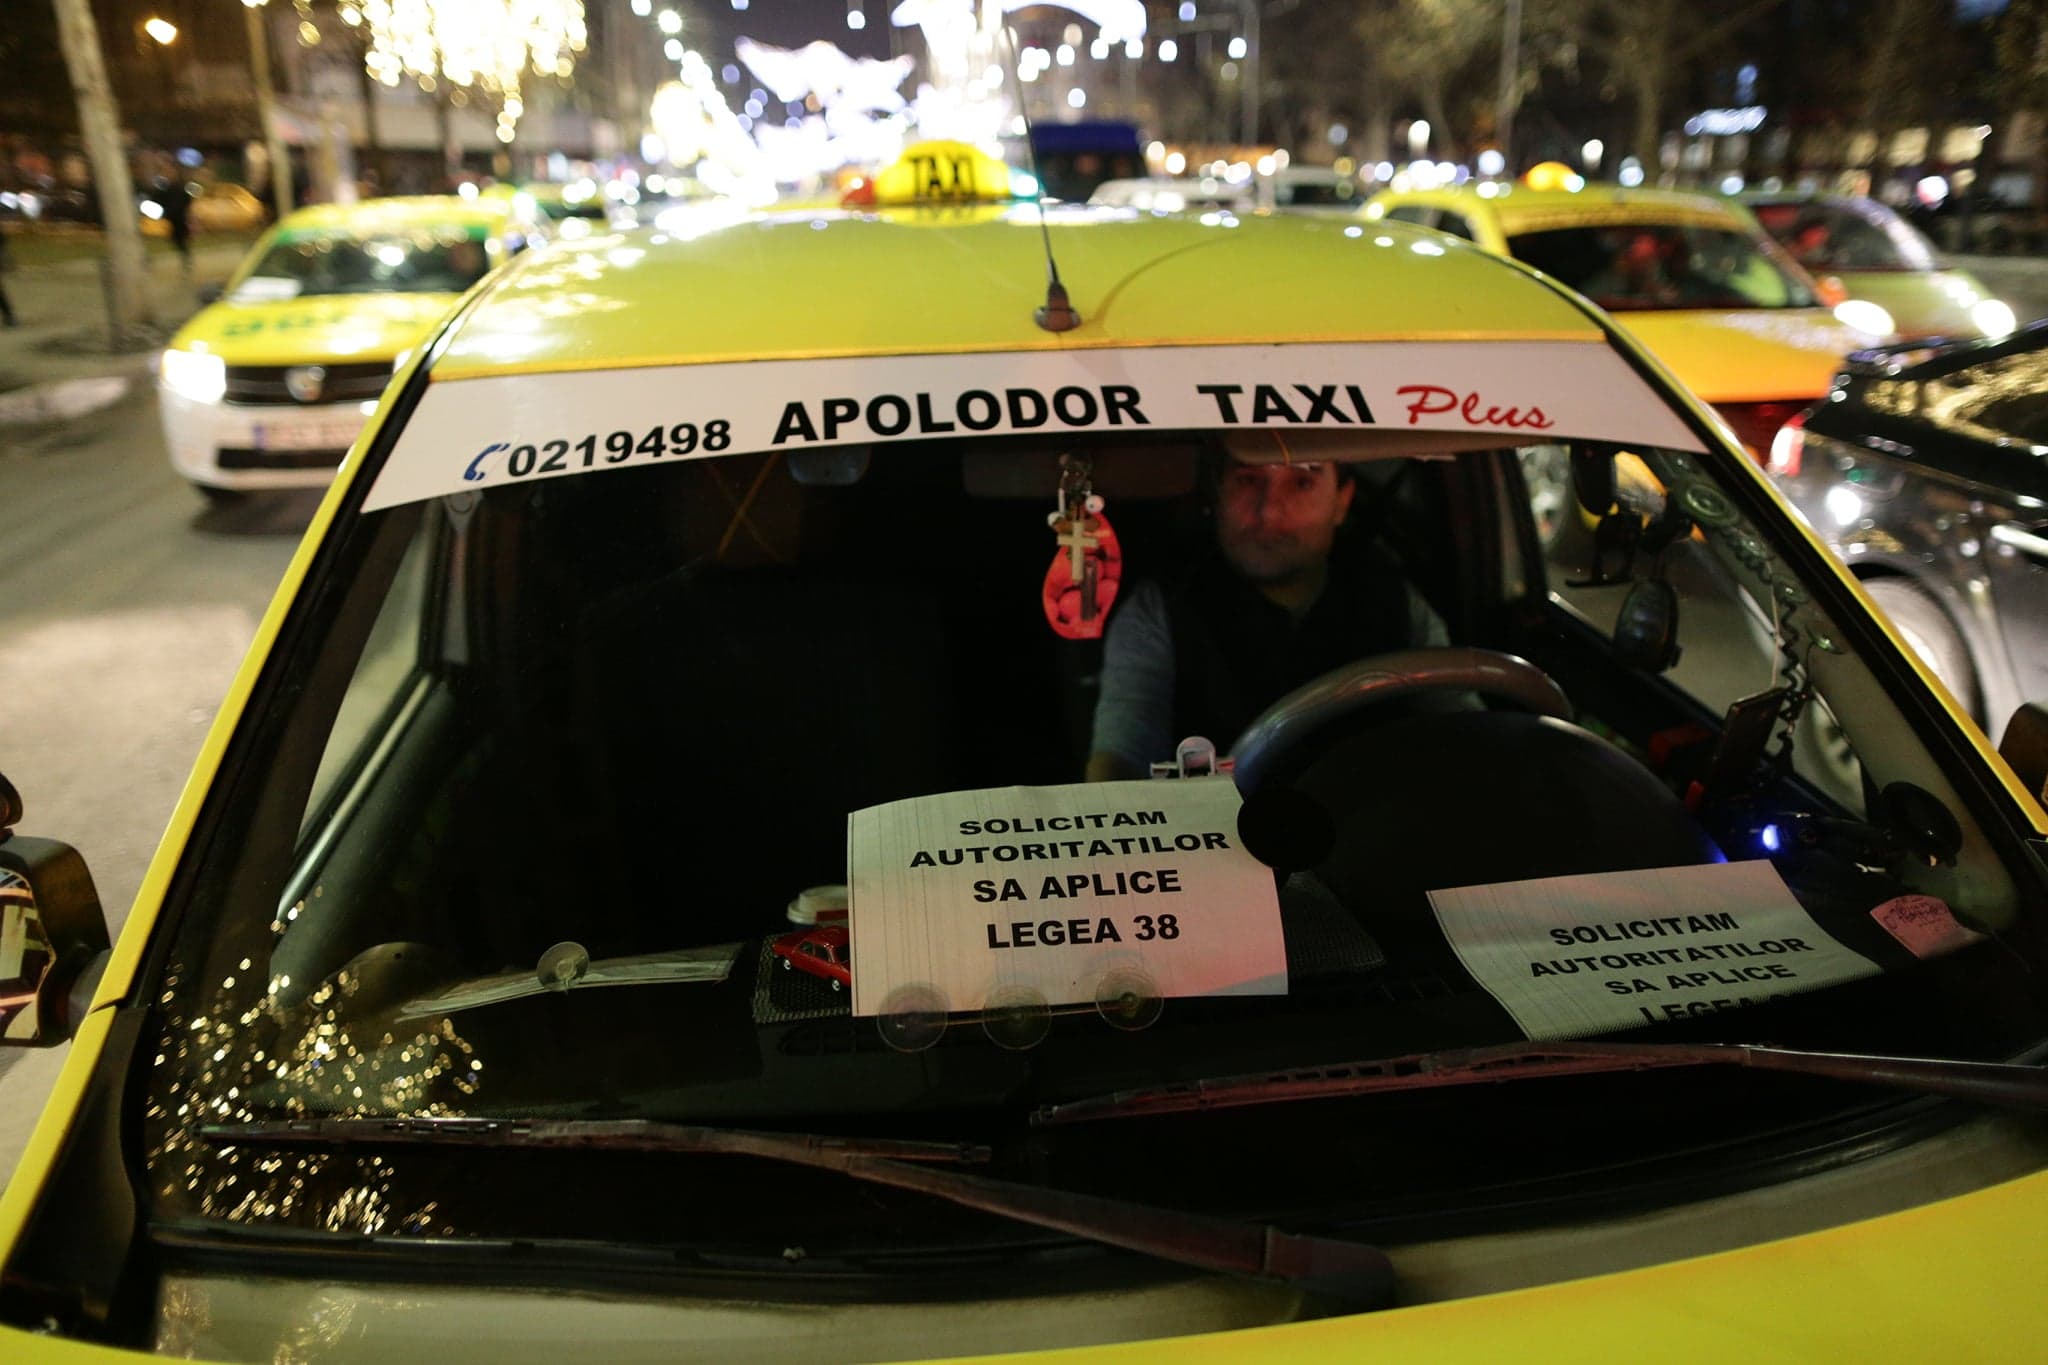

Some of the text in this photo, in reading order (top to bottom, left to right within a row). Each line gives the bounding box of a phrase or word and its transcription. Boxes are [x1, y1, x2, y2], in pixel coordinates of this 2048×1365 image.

[907, 155, 976, 200] TAXI
[507, 384, 1556, 478] 0219498 APOLODOR TAXI Plus
[959, 810, 1168, 836] SOLICITAM
[909, 831, 1232, 868] AUTORITATILOR
[973, 869, 1183, 903] SA APLICE
[986, 913, 1181, 949] LEGEA 38
[1549, 912, 1741, 946] SOLICITAM
[1530, 937, 1816, 977] AUTORITATILOR
[1604, 964, 1798, 995] SA APLICE
